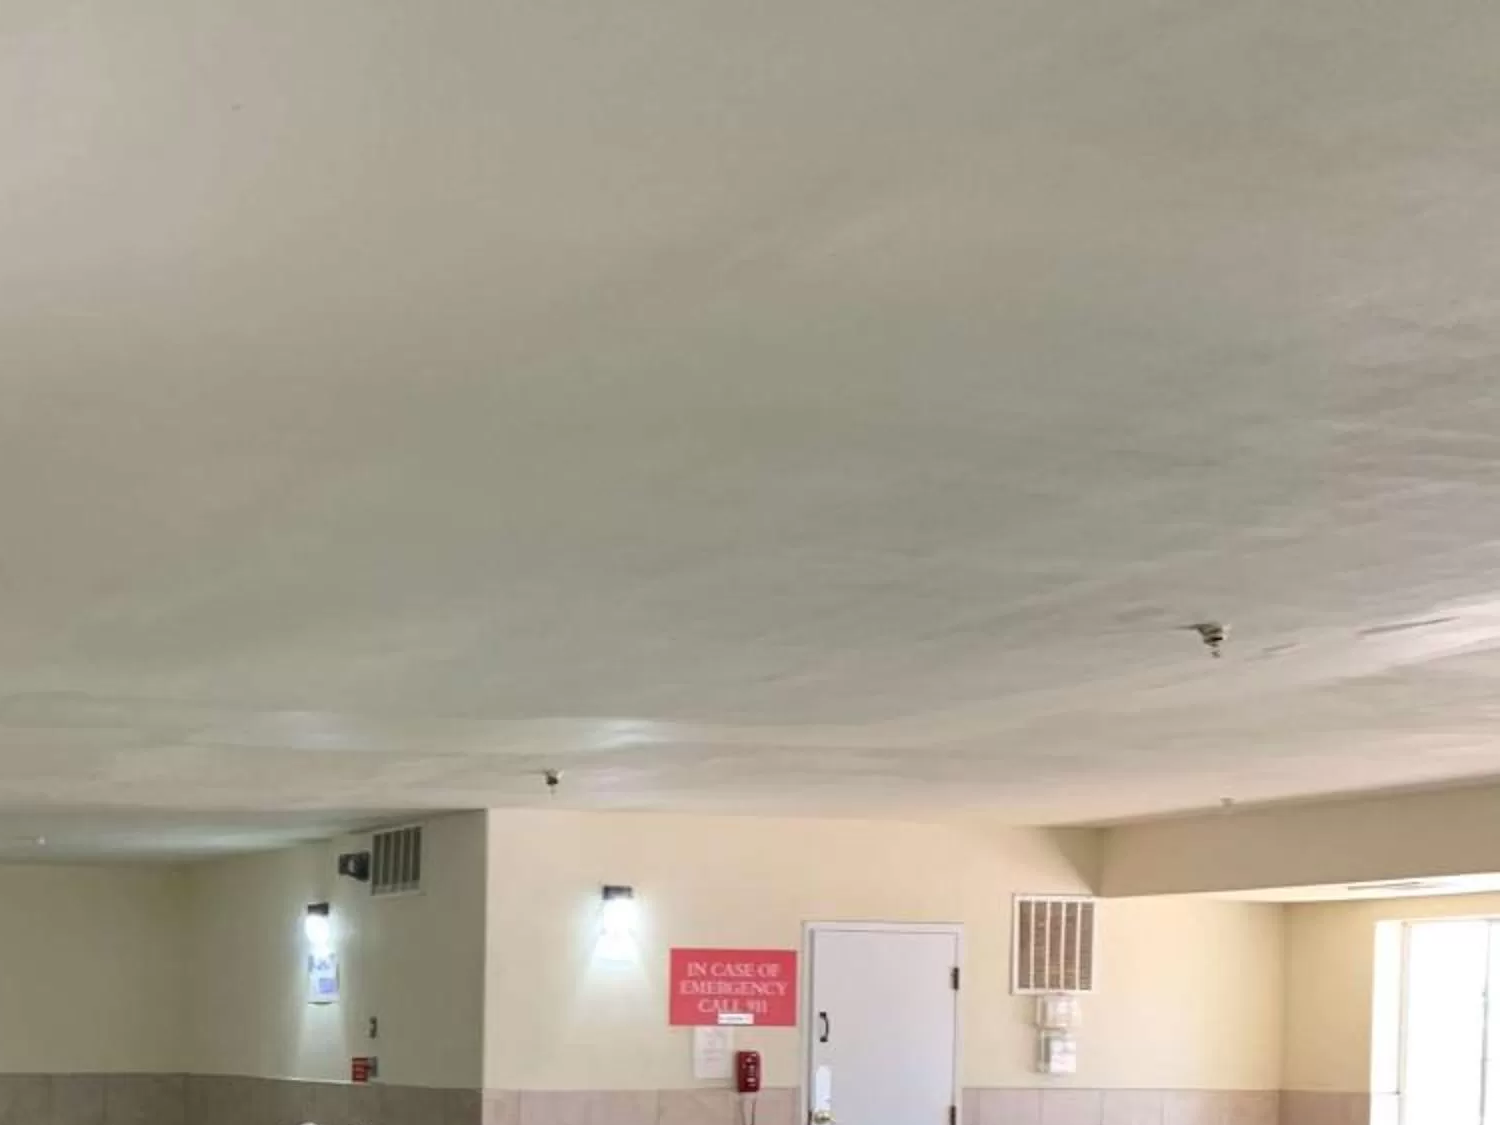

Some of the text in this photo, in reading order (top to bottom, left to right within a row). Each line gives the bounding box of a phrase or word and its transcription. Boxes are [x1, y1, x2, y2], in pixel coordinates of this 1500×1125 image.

[687, 962, 780, 977] IN CASE OF
[679, 980, 789, 996] EMERGENCY
[697, 999, 740, 1013] CALL
